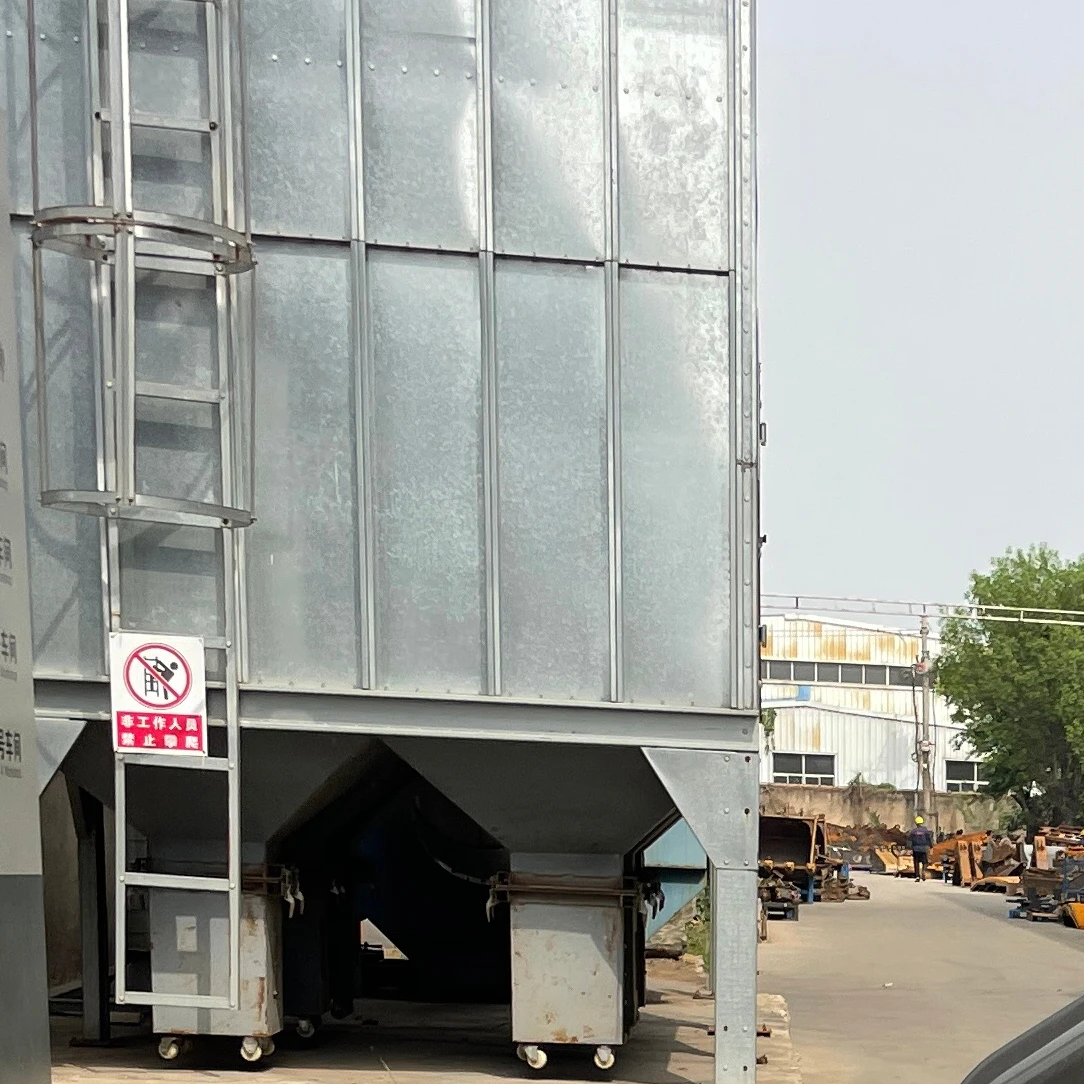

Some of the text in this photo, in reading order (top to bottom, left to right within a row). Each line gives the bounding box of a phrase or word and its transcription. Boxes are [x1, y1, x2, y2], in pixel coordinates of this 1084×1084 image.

[121, 714, 198, 732] 非工作人员
[121, 732, 199, 749] 禁止攀爬
